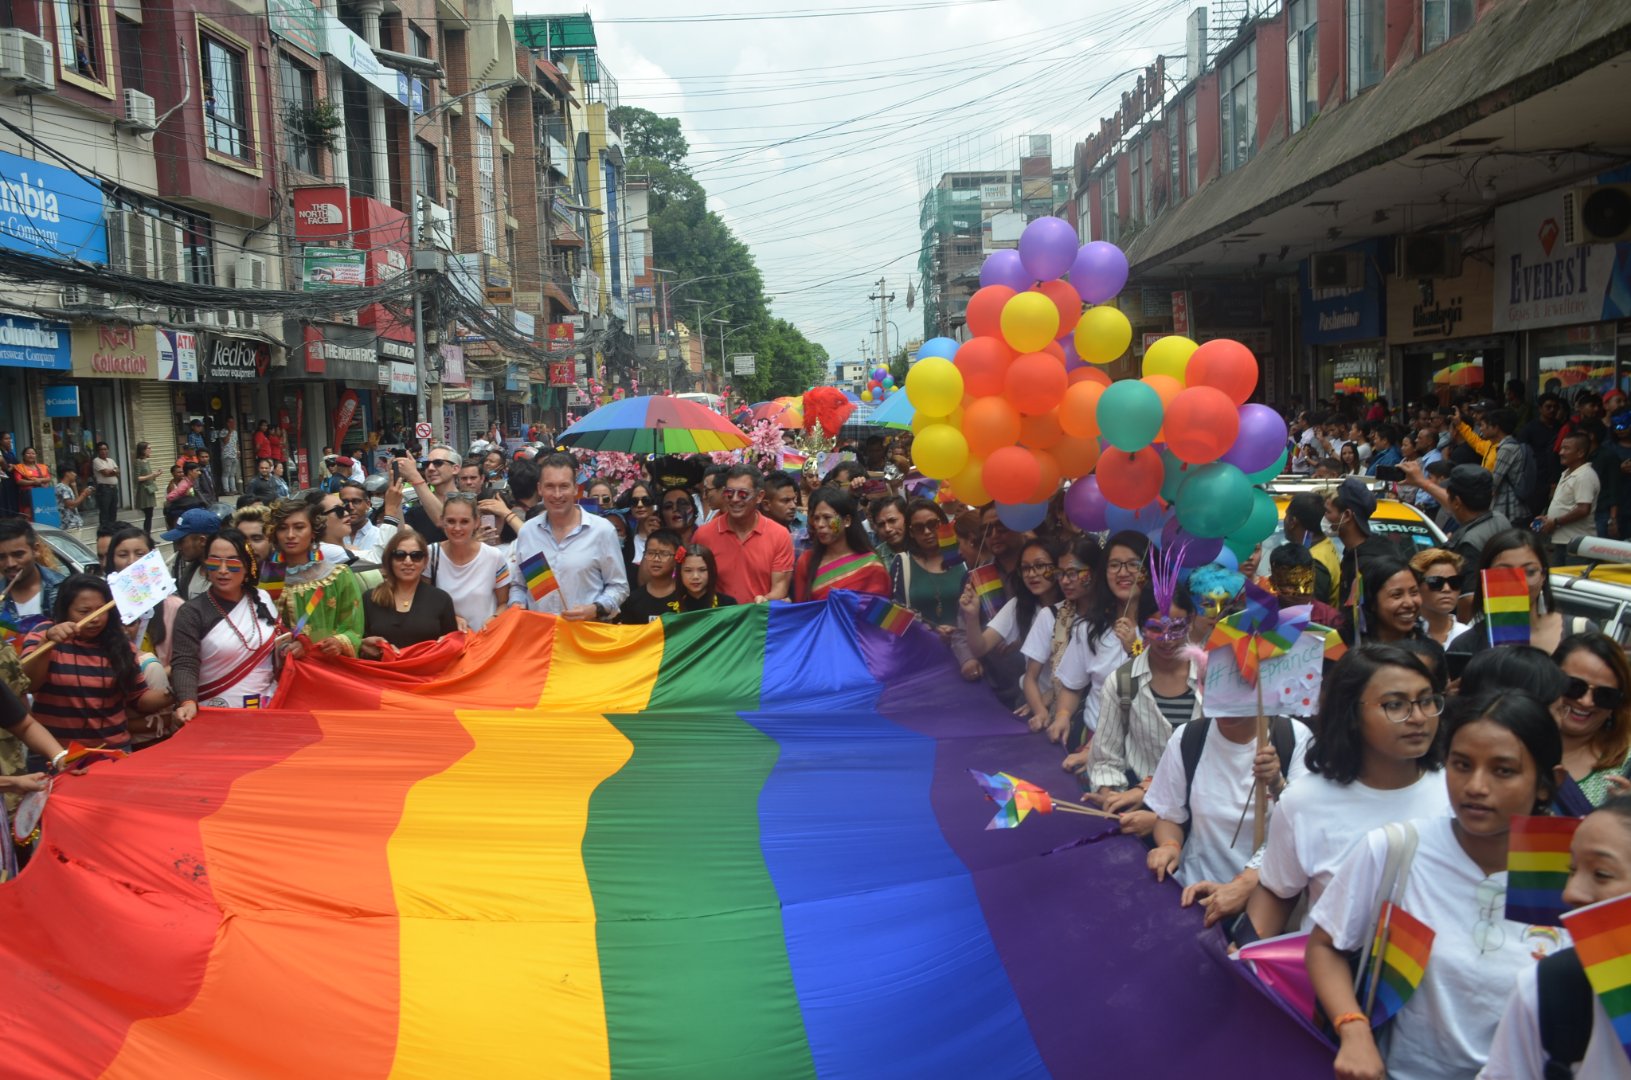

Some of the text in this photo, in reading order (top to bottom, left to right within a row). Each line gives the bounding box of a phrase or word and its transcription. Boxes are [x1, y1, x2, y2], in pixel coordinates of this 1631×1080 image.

[0, 172, 60, 223] mbia
[311, 203, 328, 211] THE
[298, 210, 328, 218] NORTH
[307, 217, 329, 225] FACE
[8, 216, 59, 249] Company
[1510, 245, 1591, 305] EVEREST
[177, 334, 196, 350] ATM
[25, 348, 56, 367] Company
[211, 340, 257, 367] RedFox
[324, 343, 338, 359] THE
[338, 346, 361, 361] NORTH
[361, 348, 377, 363] FACE
[211, 367, 256, 380] outdoor equipment
